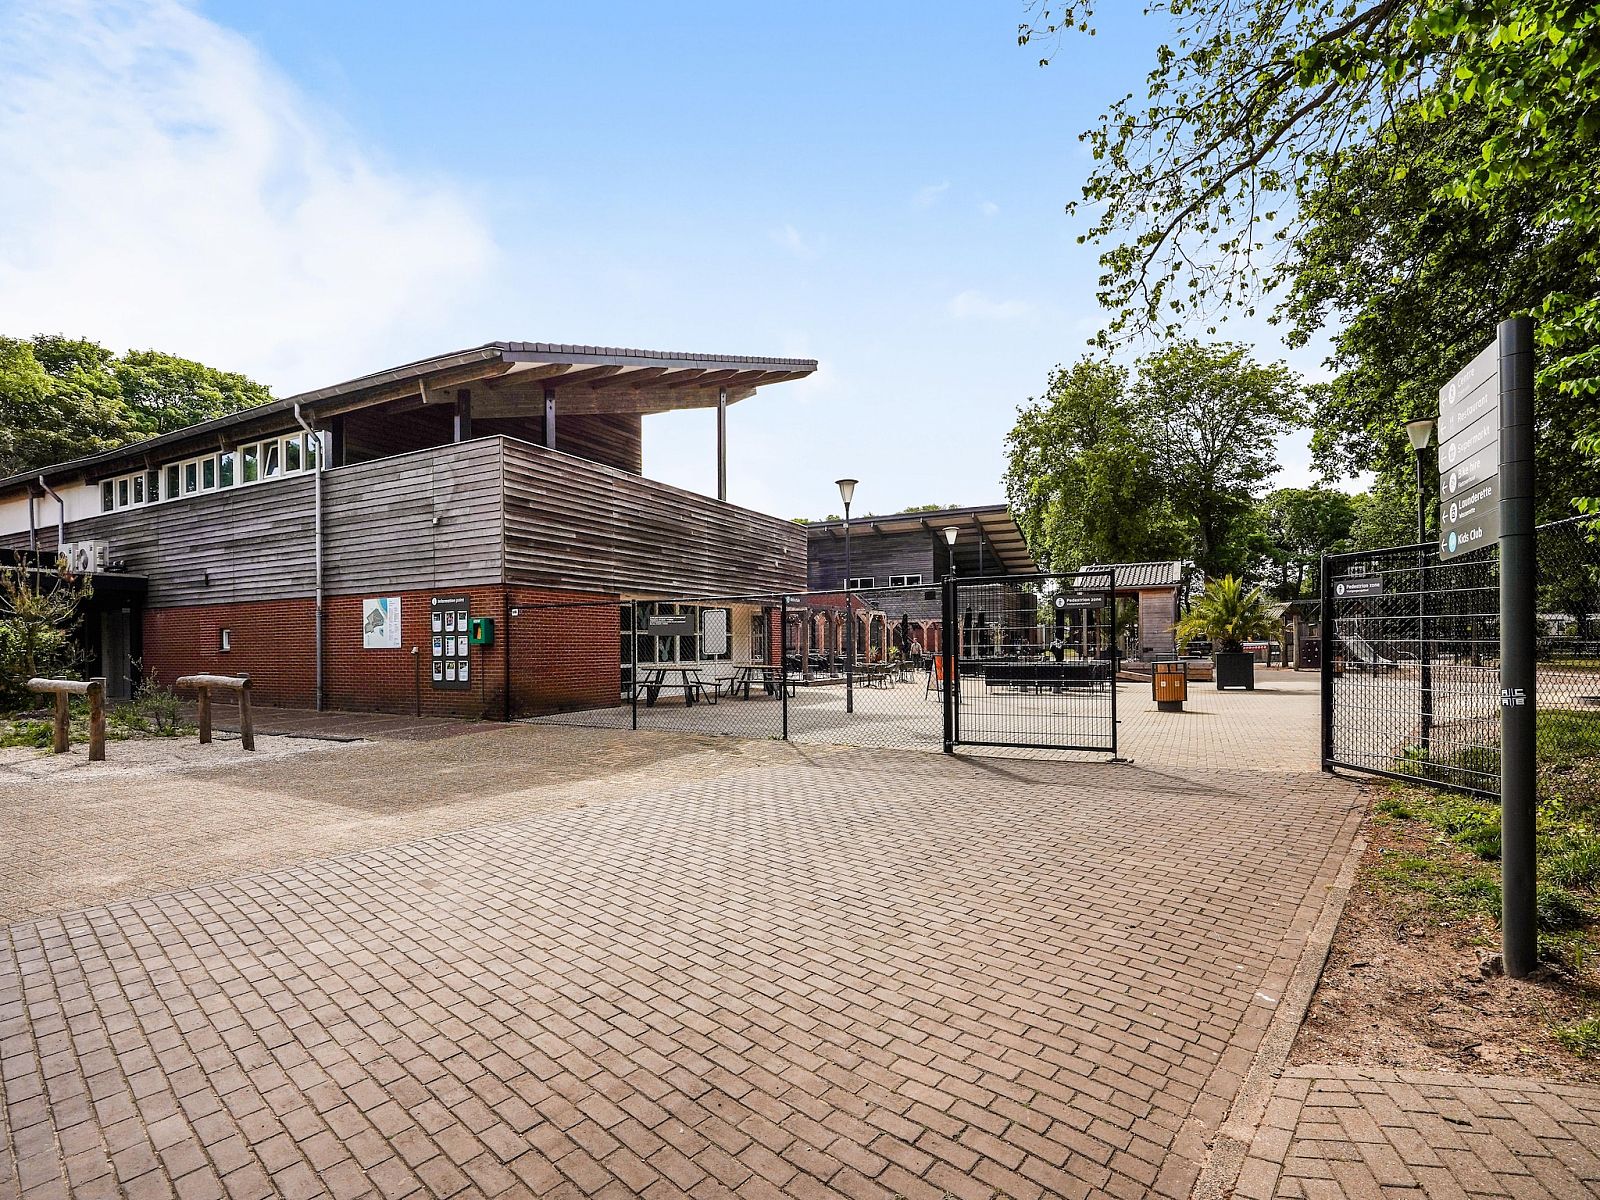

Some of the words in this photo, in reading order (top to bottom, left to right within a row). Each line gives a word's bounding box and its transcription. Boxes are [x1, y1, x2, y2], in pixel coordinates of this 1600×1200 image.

[1457, 368, 1475, 388] Centre
[1457, 394, 1488, 423] Restaurant
[1457, 425, 1490, 453] Supermarkt
[1458, 467, 1469, 479] Bike
[1469, 459, 1481, 473] hire
[1458, 486, 1492, 510] Launderette
[1457, 532, 1469, 545] Kids
[1470, 526, 1483, 541] Club
